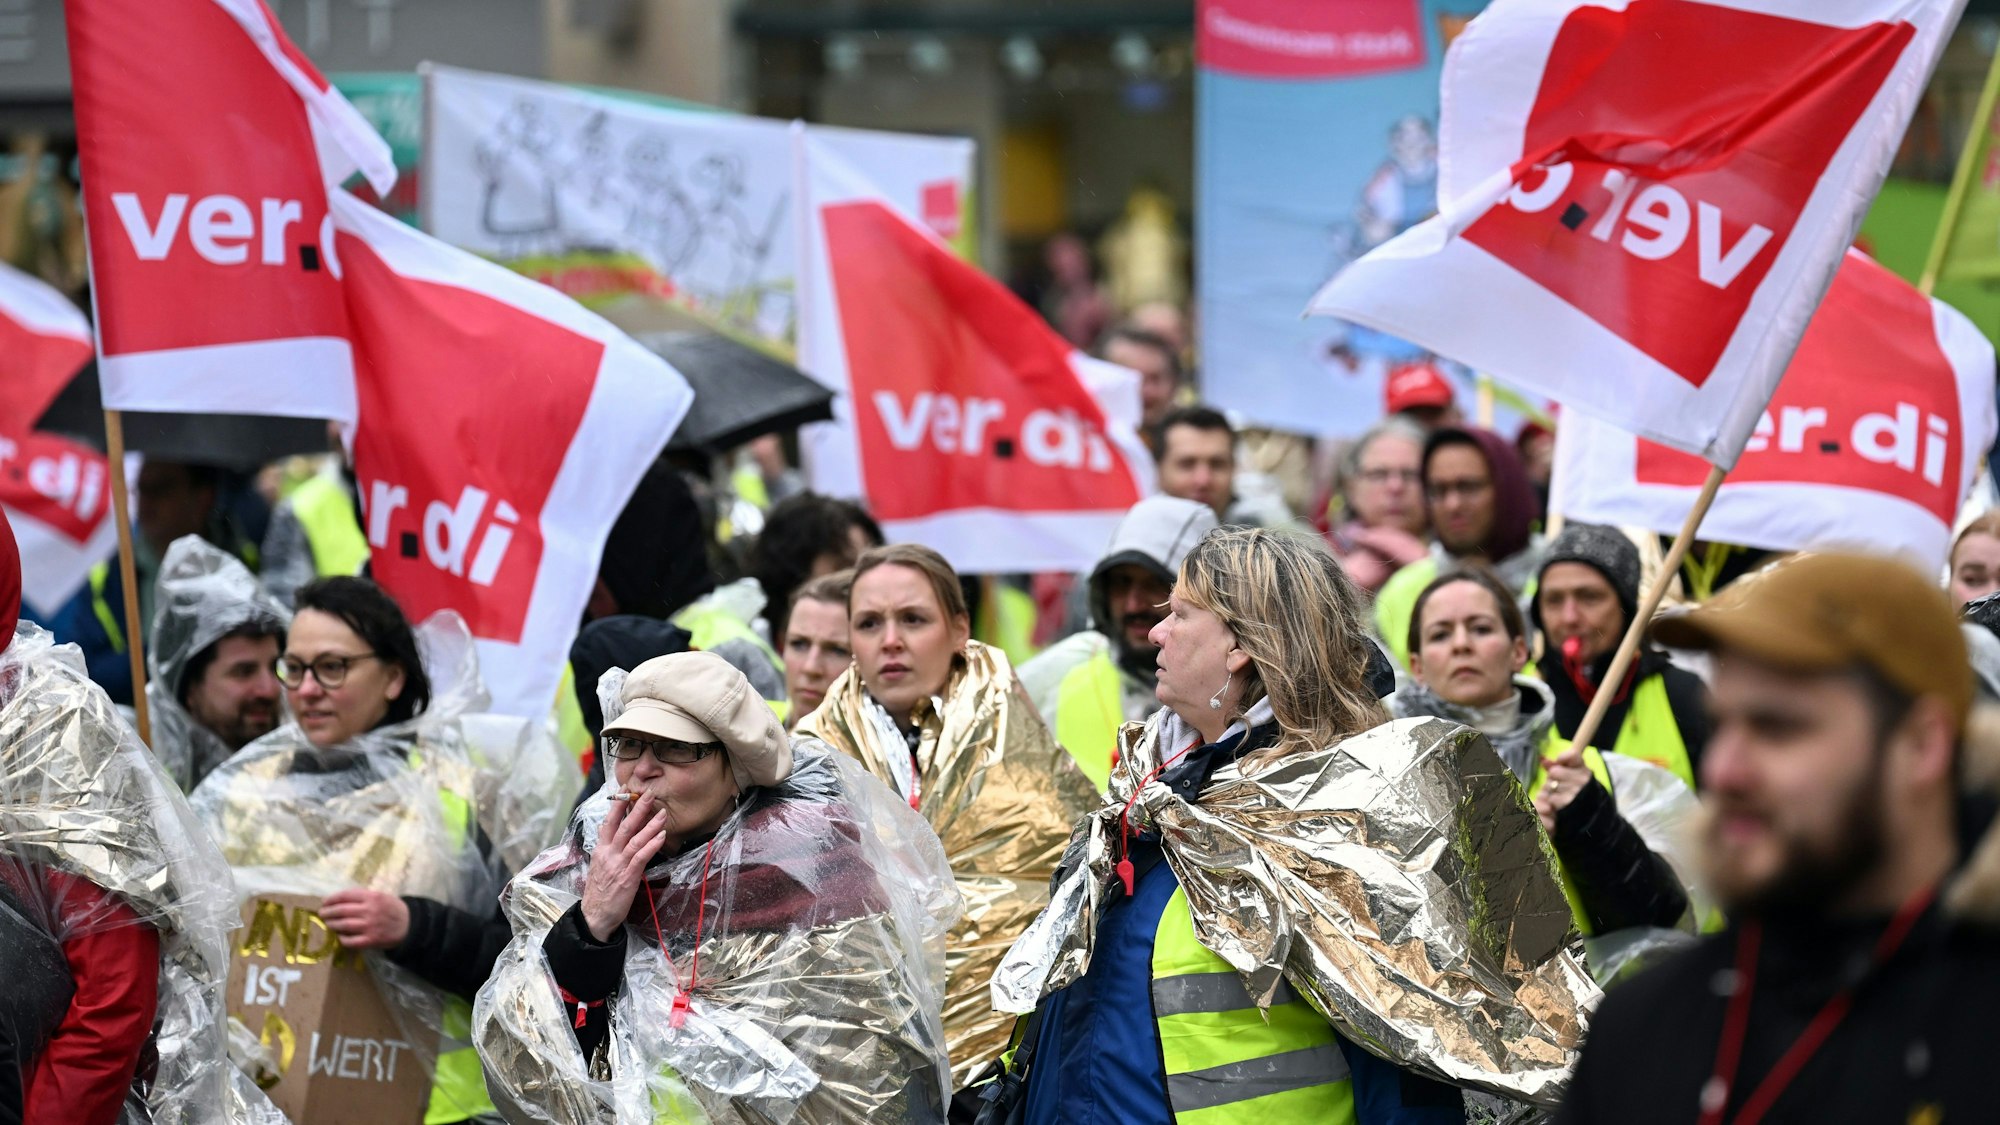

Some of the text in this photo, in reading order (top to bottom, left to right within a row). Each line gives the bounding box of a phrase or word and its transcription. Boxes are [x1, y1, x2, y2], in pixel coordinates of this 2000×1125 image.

[357, 479, 520, 587] r.di
[244, 964, 302, 1007] IST
[307, 1031, 411, 1082] WERT
